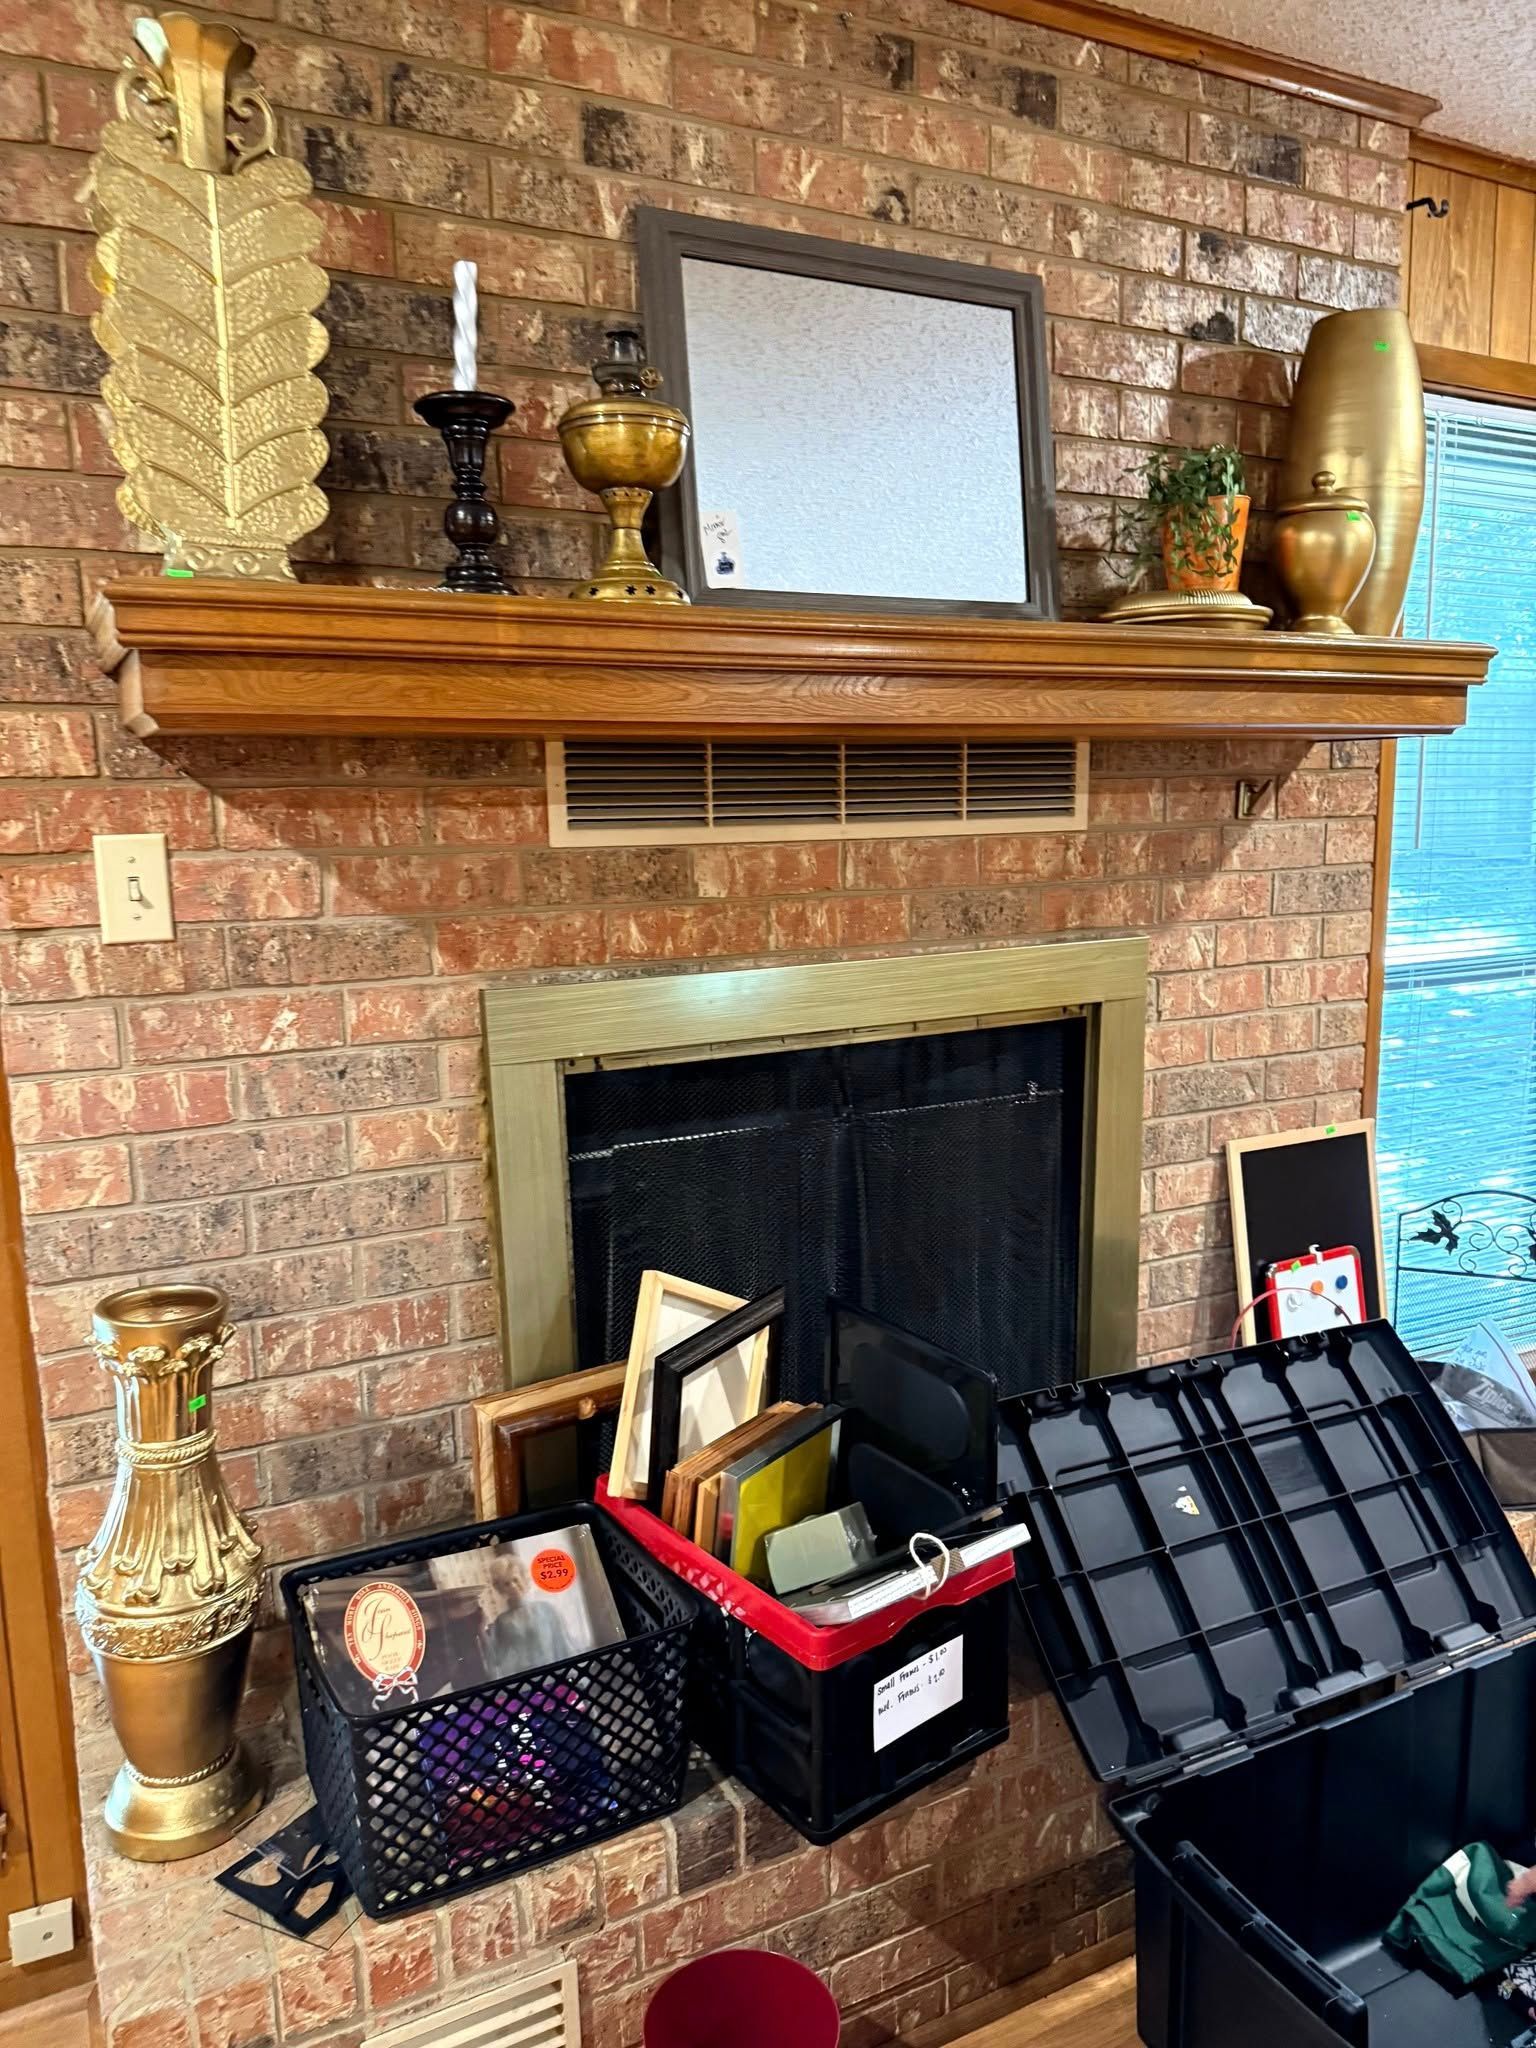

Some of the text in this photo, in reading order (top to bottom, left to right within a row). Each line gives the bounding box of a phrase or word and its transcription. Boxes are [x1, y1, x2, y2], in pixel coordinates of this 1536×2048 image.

[1467, 1377, 1514, 1414] Ziploc
[537, 1555, 565, 1563] SPECIAL
[540, 1569, 569, 1580] $2.99
[878, 1677, 895, 1696] Small
[900, 1665, 920, 1682] Frames
[897, 1683, 920, 1703] Frames
